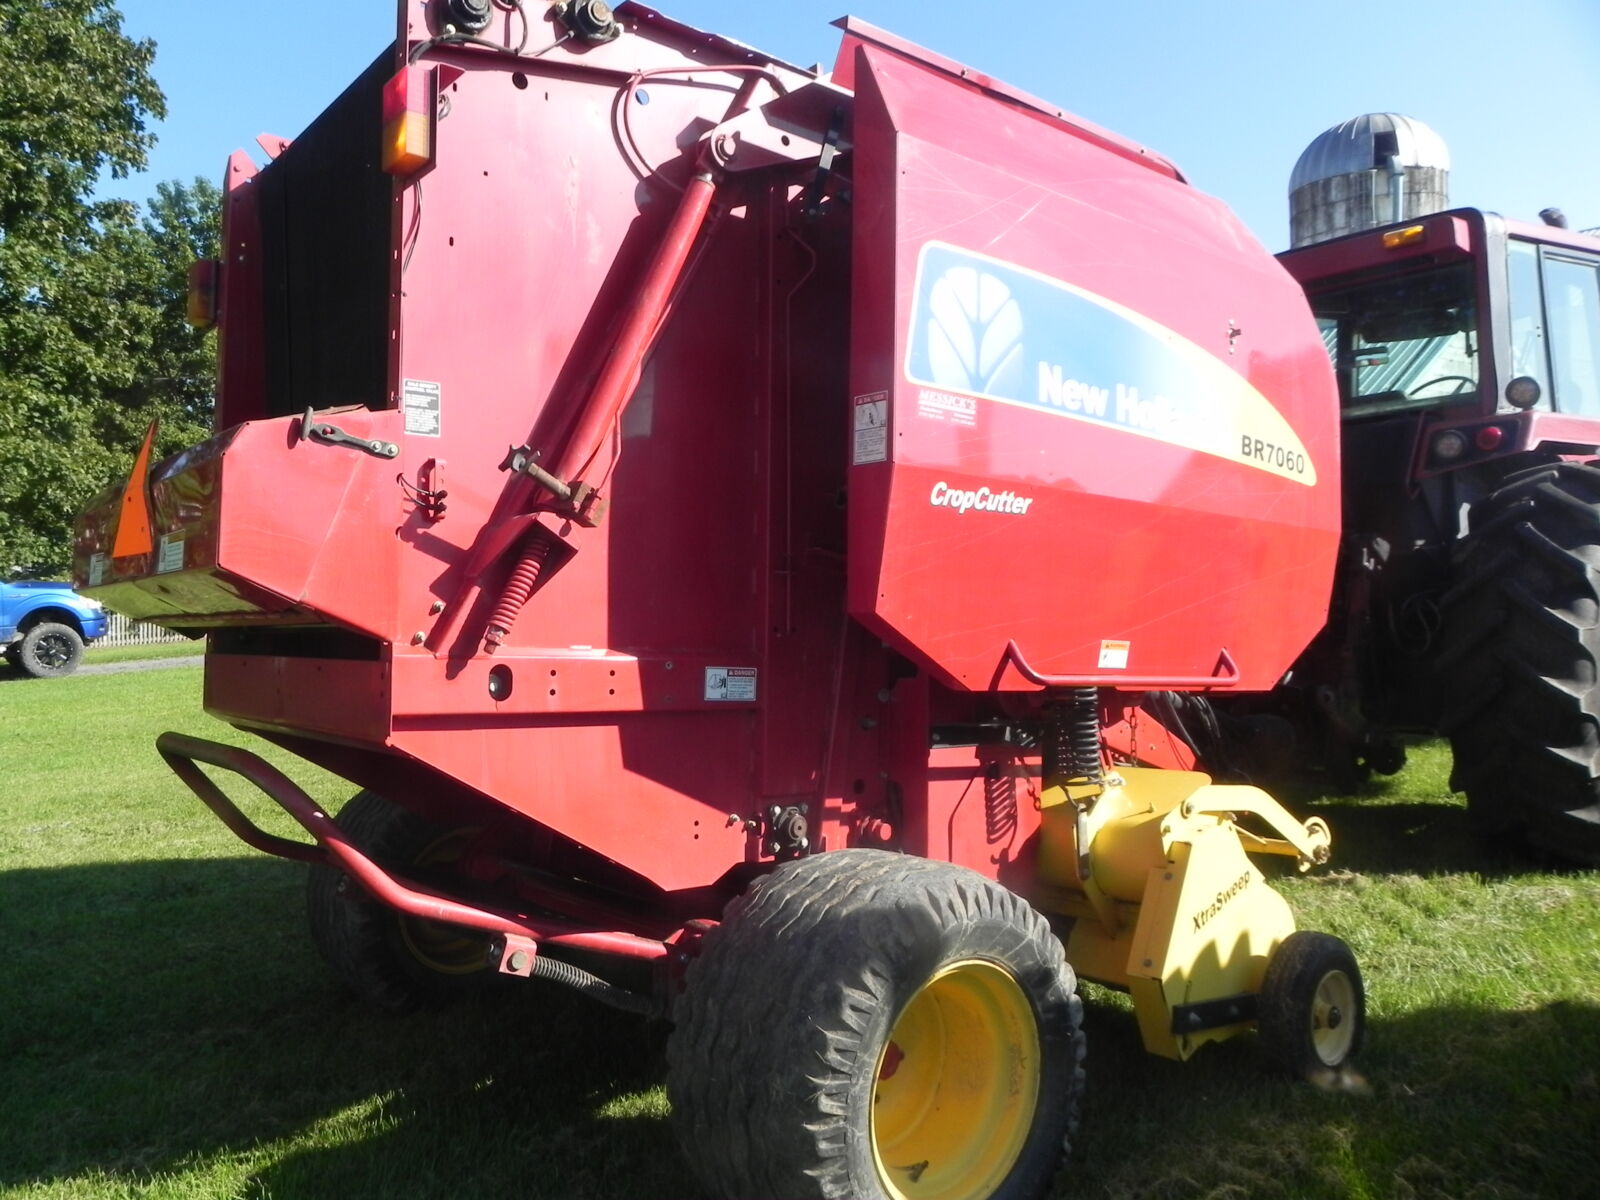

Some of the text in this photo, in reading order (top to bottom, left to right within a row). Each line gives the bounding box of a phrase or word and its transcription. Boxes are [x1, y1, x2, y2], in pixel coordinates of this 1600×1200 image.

[1038, 361, 1109, 417] New
[1241, 434, 1305, 475] BR7060
[930, 481, 1034, 516] CropCutter
[1193, 870, 1250, 934] XtraSweep
